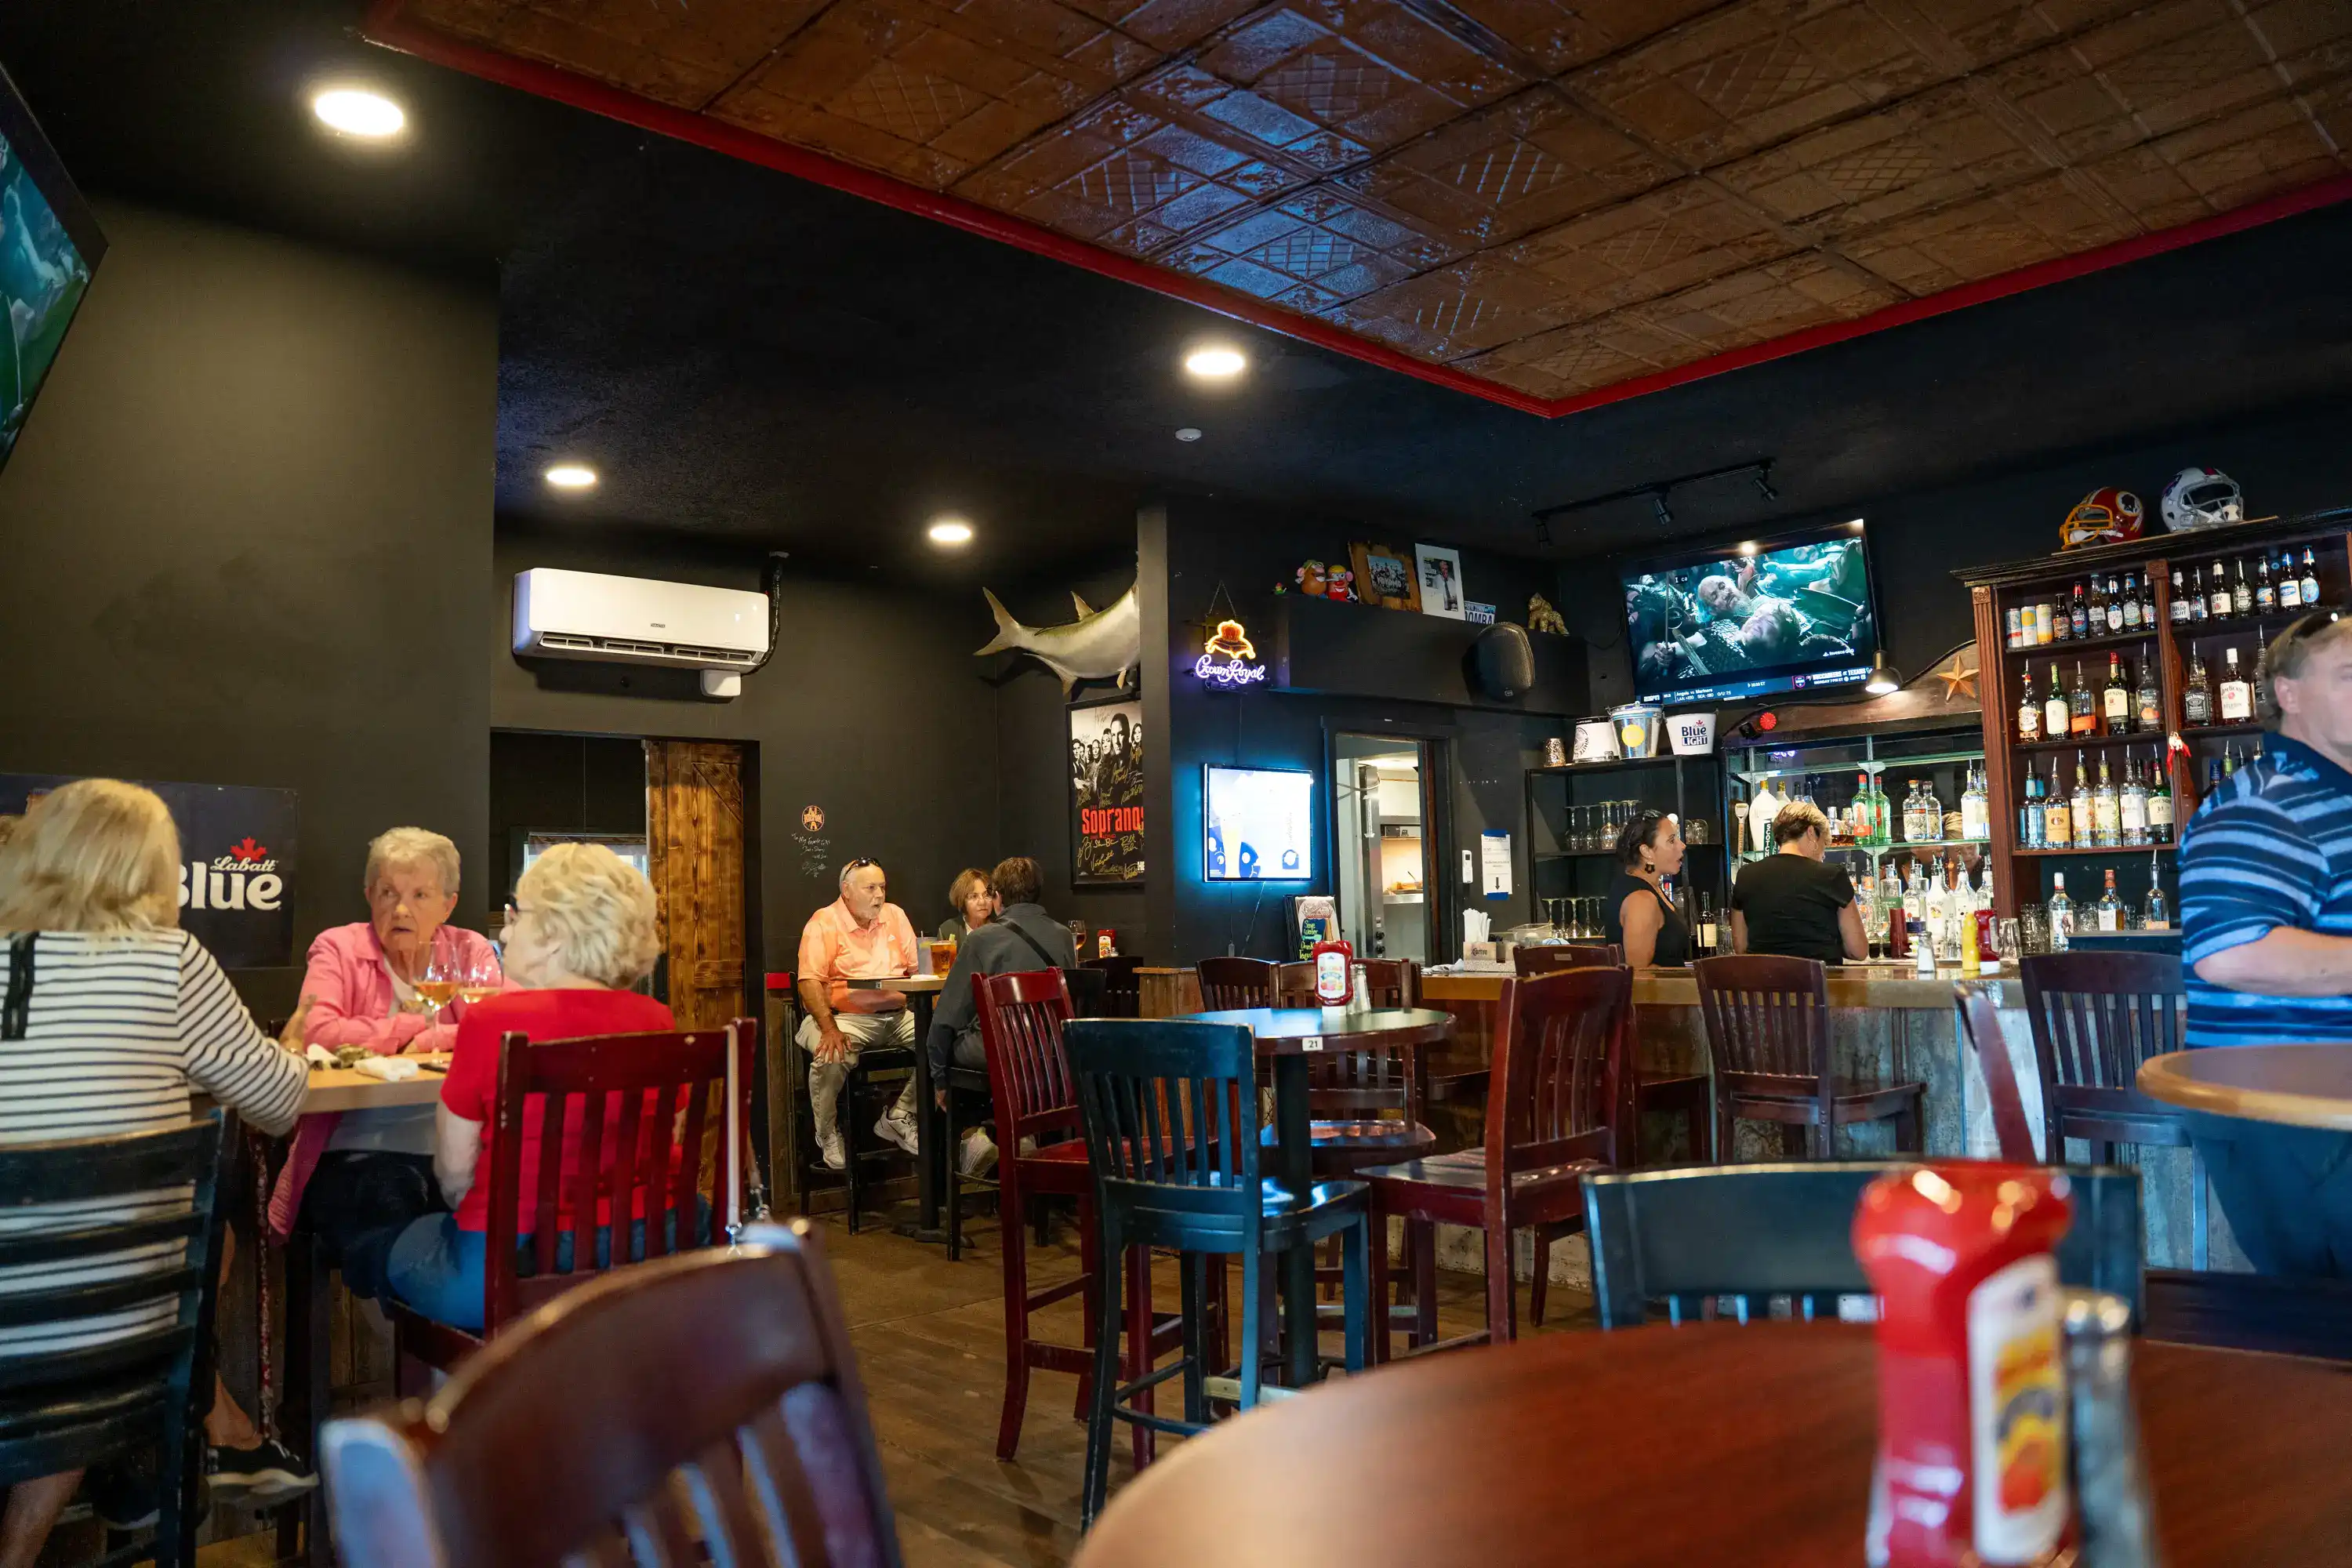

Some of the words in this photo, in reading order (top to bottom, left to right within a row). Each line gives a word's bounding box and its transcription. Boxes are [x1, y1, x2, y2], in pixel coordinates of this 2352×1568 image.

[1196, 654, 1232, 679] Crown
[1229, 659, 1265, 684] Royal
[1682, 726, 1707, 736] Blue
[1682, 736, 1708, 746] LIGHT
[210, 855, 276, 872] Labatt
[1308, 1040, 1318, 1048] 21
